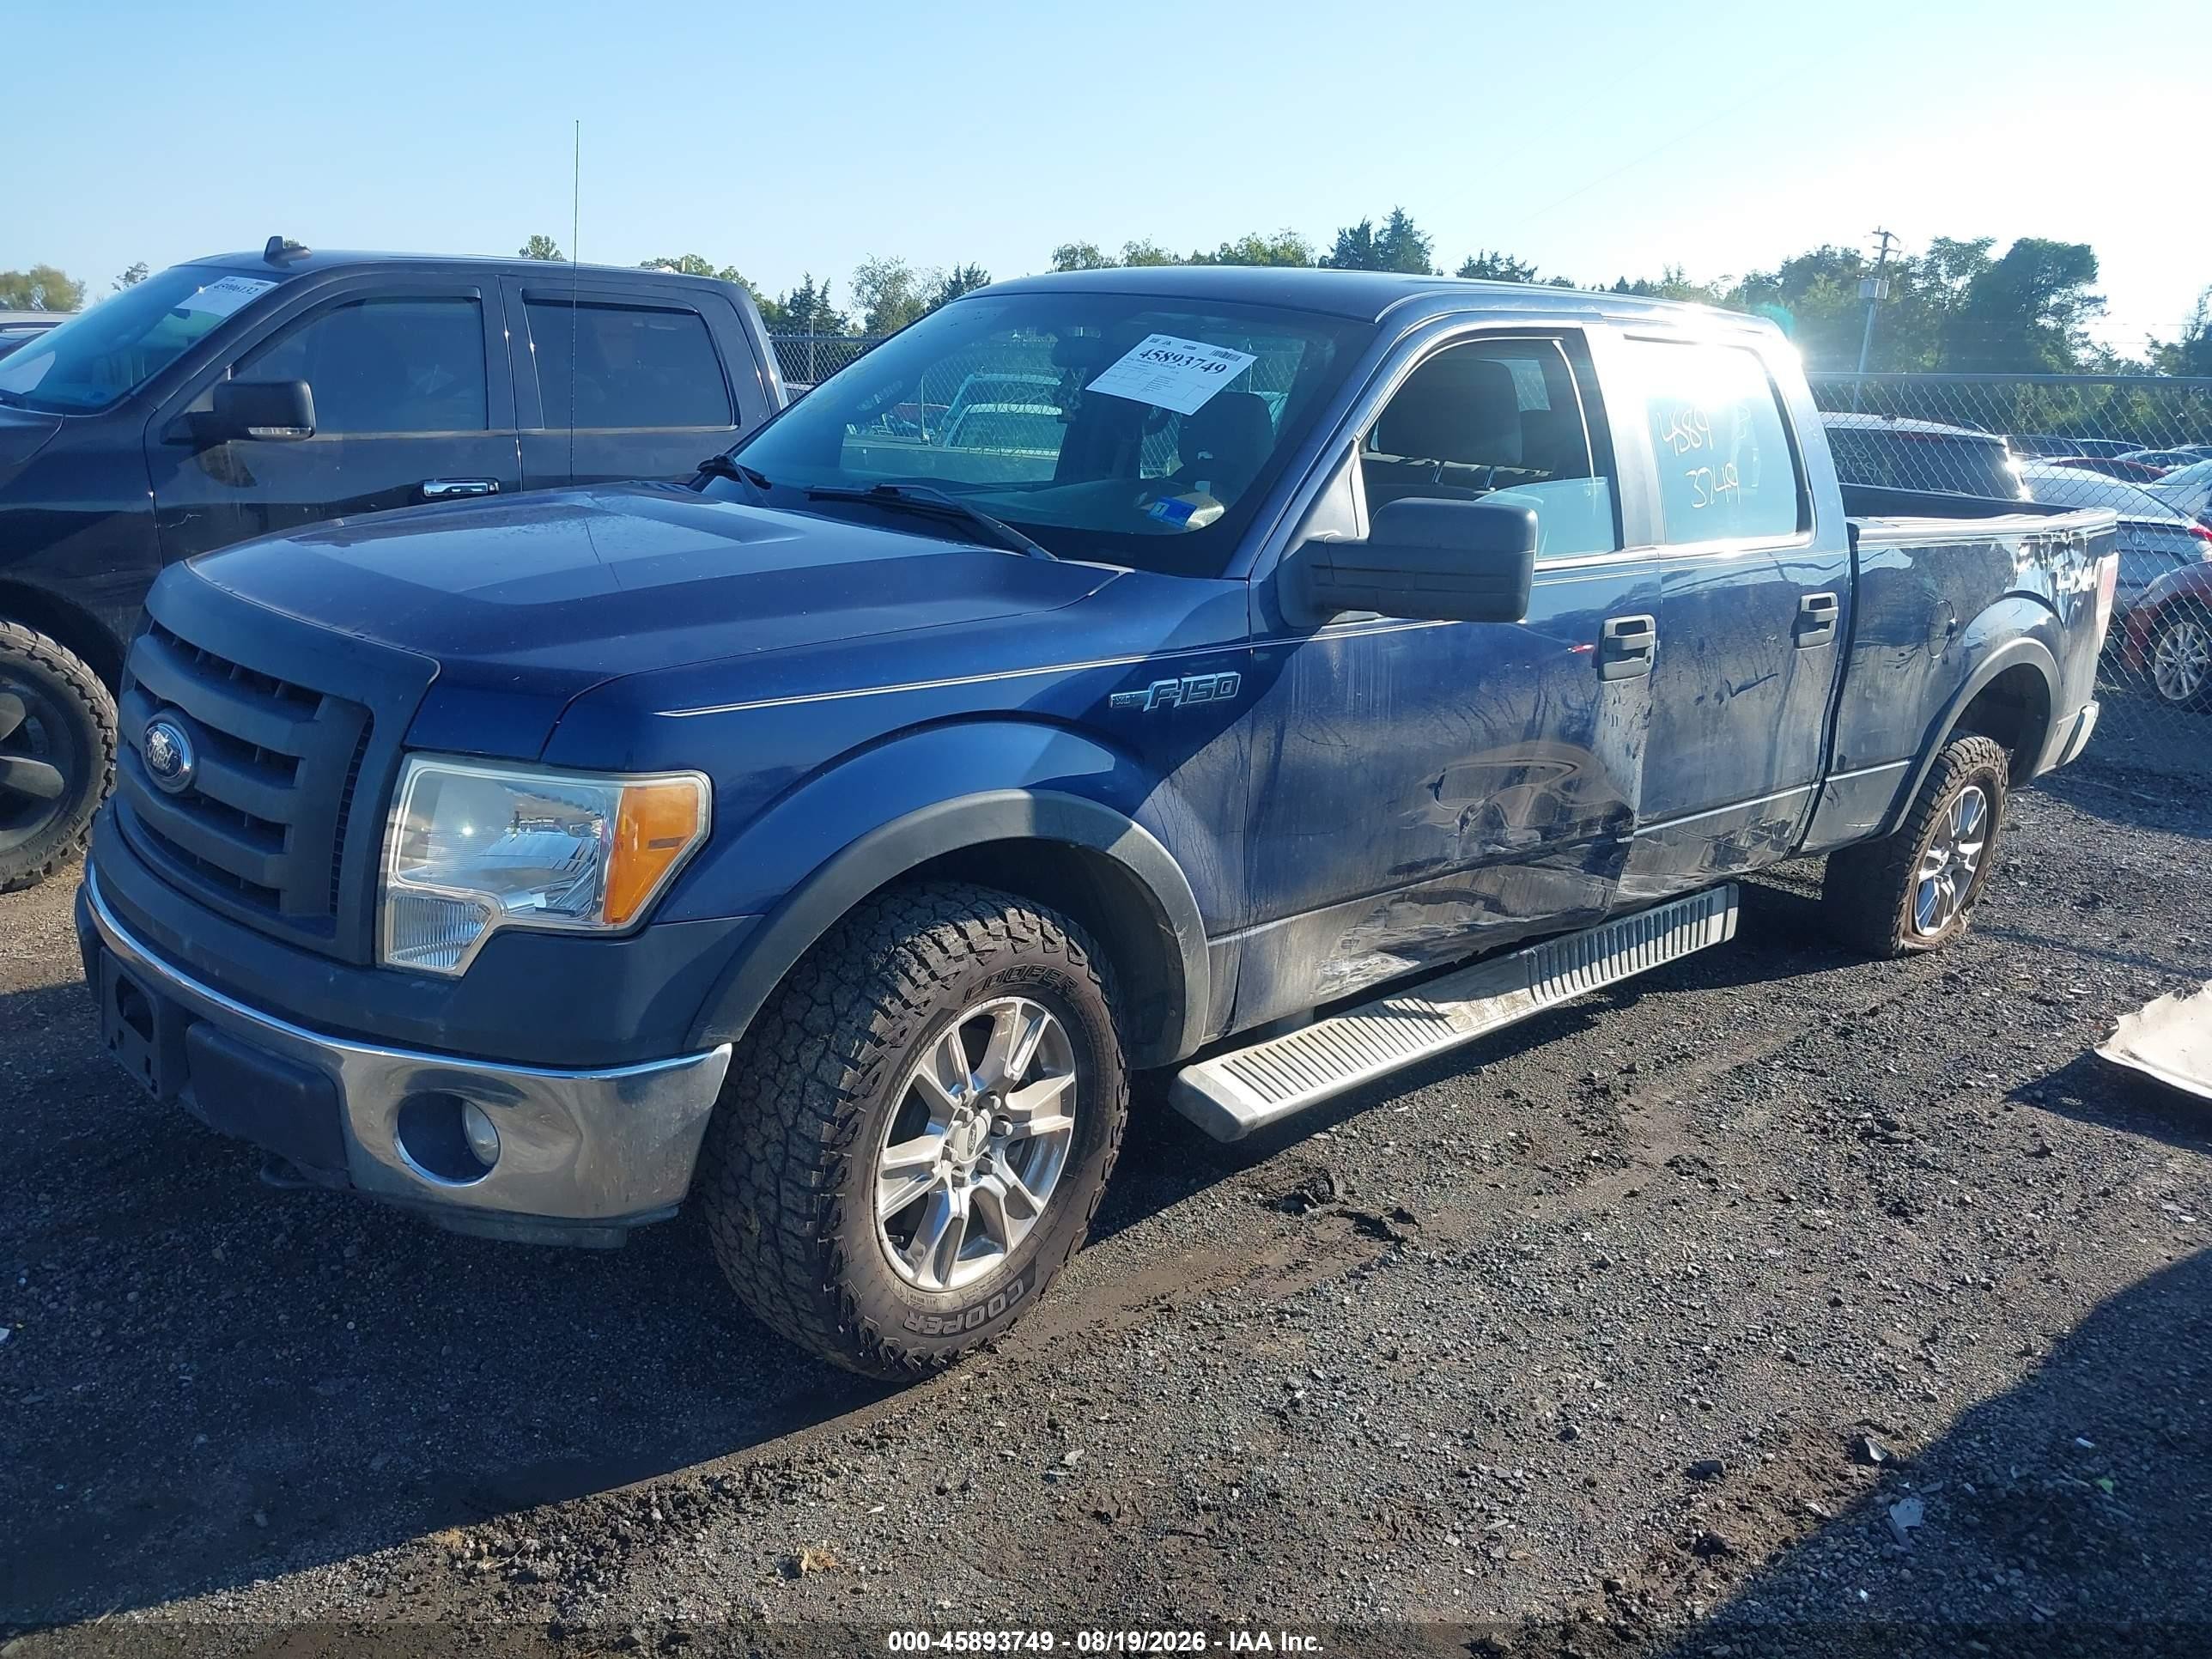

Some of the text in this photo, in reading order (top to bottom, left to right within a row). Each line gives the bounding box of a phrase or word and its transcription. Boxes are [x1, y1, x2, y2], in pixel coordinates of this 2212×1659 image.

[1139, 348, 1227, 374] 45893749
[1656, 405, 1714, 457] 4589
[1143, 671, 1241, 712] F-150
[148, 731, 173, 770] Ford
[963, 963, 1079, 1004] COOPER
[902, 1278, 1024, 1334] COOPER
